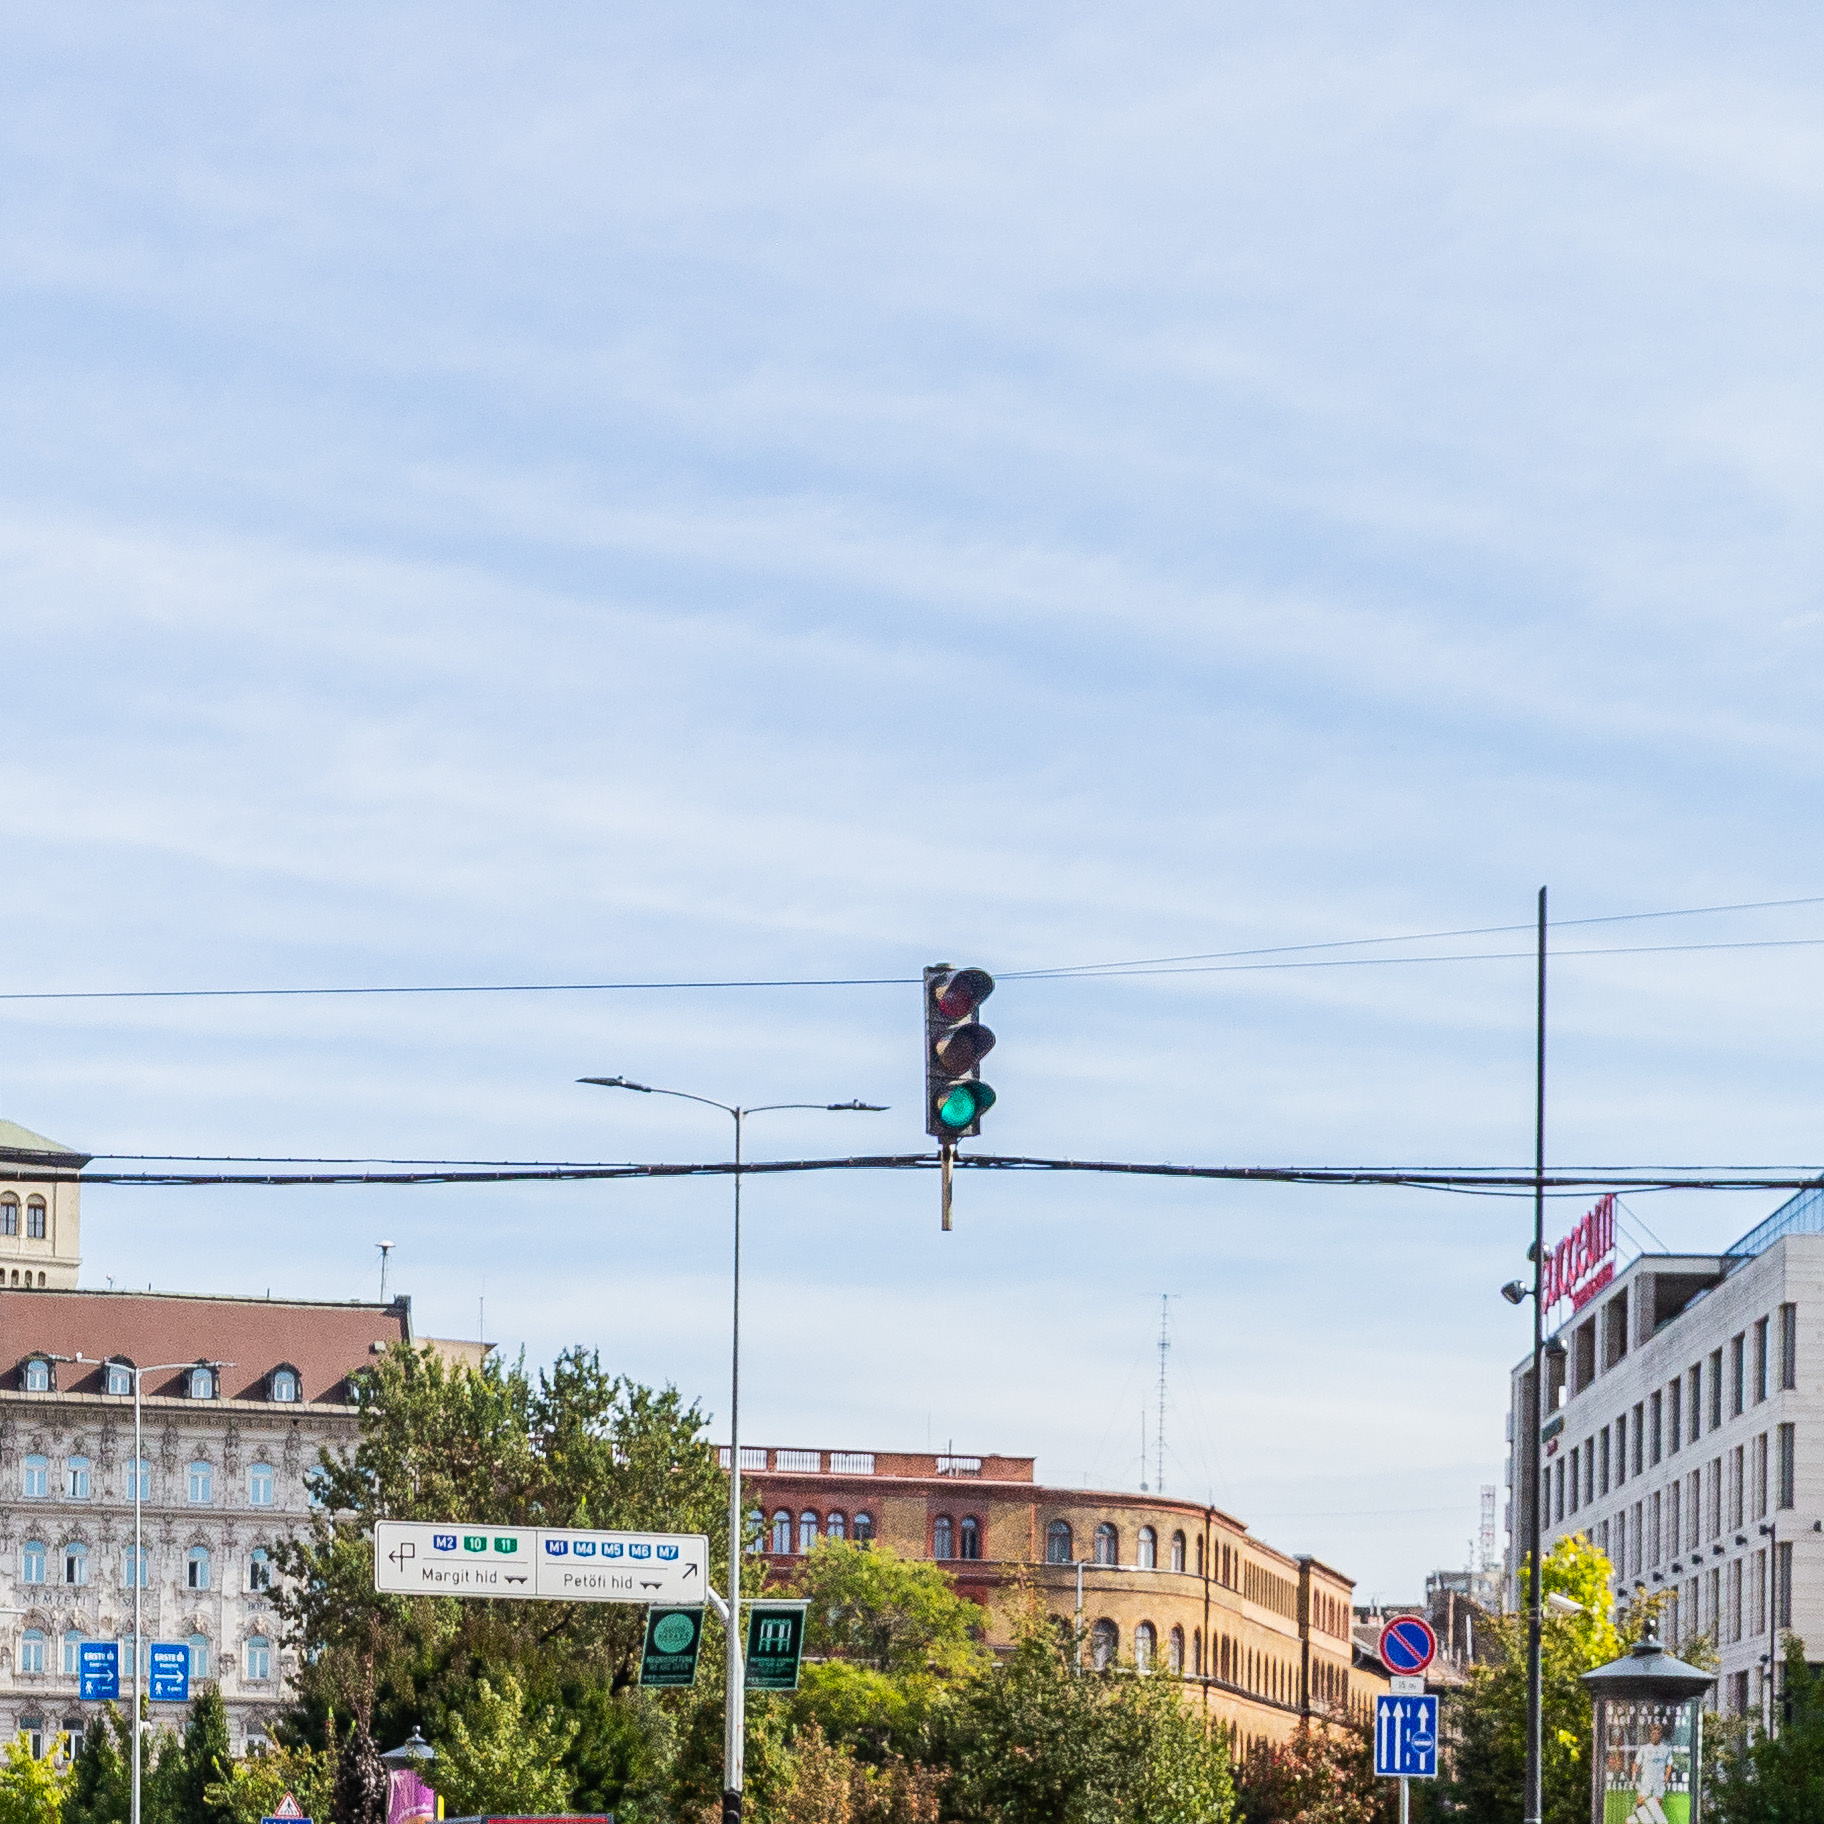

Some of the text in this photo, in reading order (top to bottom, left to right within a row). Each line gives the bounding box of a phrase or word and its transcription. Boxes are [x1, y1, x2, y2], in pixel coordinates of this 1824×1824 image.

[434, 1536, 512, 1551] M2 10 11
[549, 1540, 677, 1559] M1 M4 M5 M6 M7
[422, 1567, 470, 1585] Margit
[248, 1601, 270, 1612] HOTE
